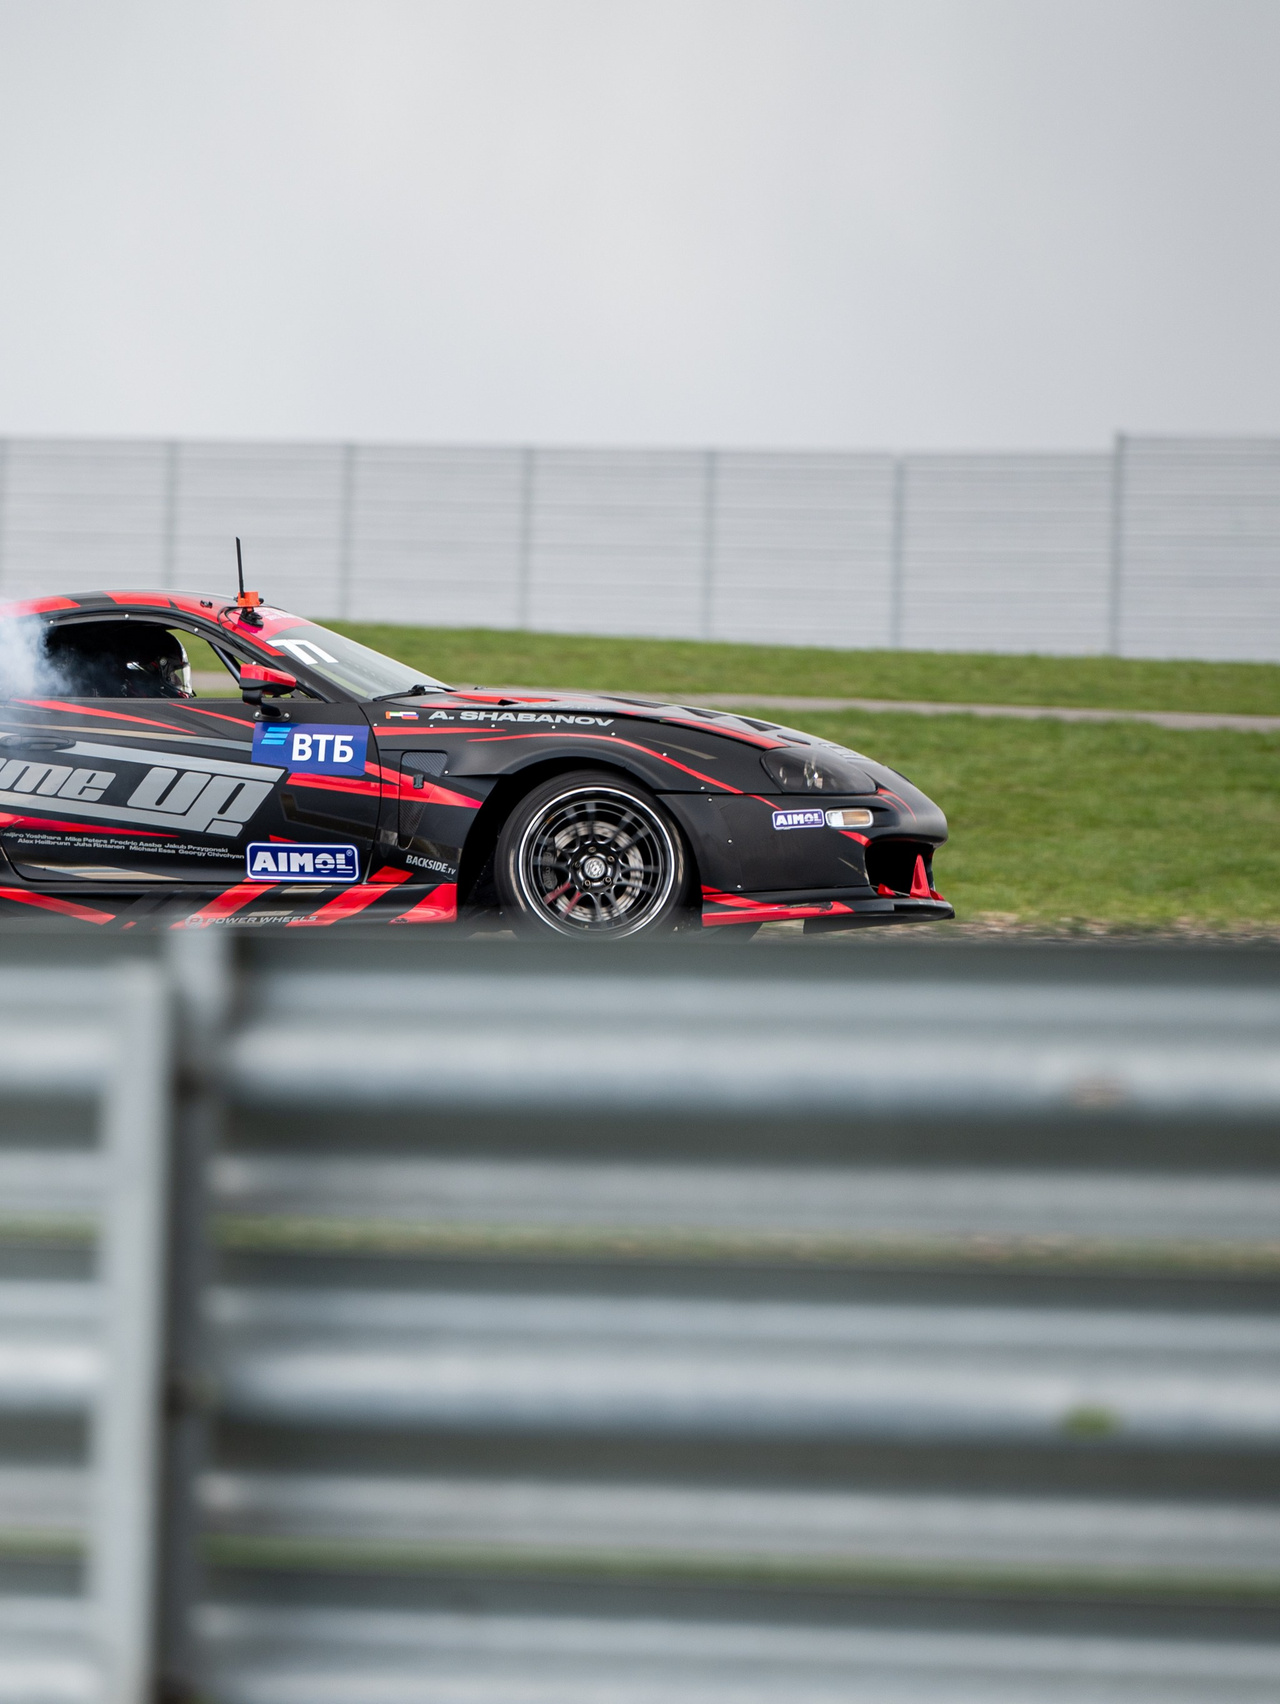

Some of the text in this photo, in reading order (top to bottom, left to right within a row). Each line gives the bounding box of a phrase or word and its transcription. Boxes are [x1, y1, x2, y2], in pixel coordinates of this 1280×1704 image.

[428, 711, 614, 727] A. SHABANOV
[292, 733, 354, 763] ВТБ
[775, 812, 822, 826] AIMOL
[25, 832, 62, 841] Yoshihara
[164, 842, 187, 850] Jakub
[178, 849, 206, 857] Georgy
[207, 851, 245, 859] Chivchyan
[252, 851, 354, 874] AIMOL
[205, 916, 256, 924] POWER
[260, 915, 318, 923] WHEELS
